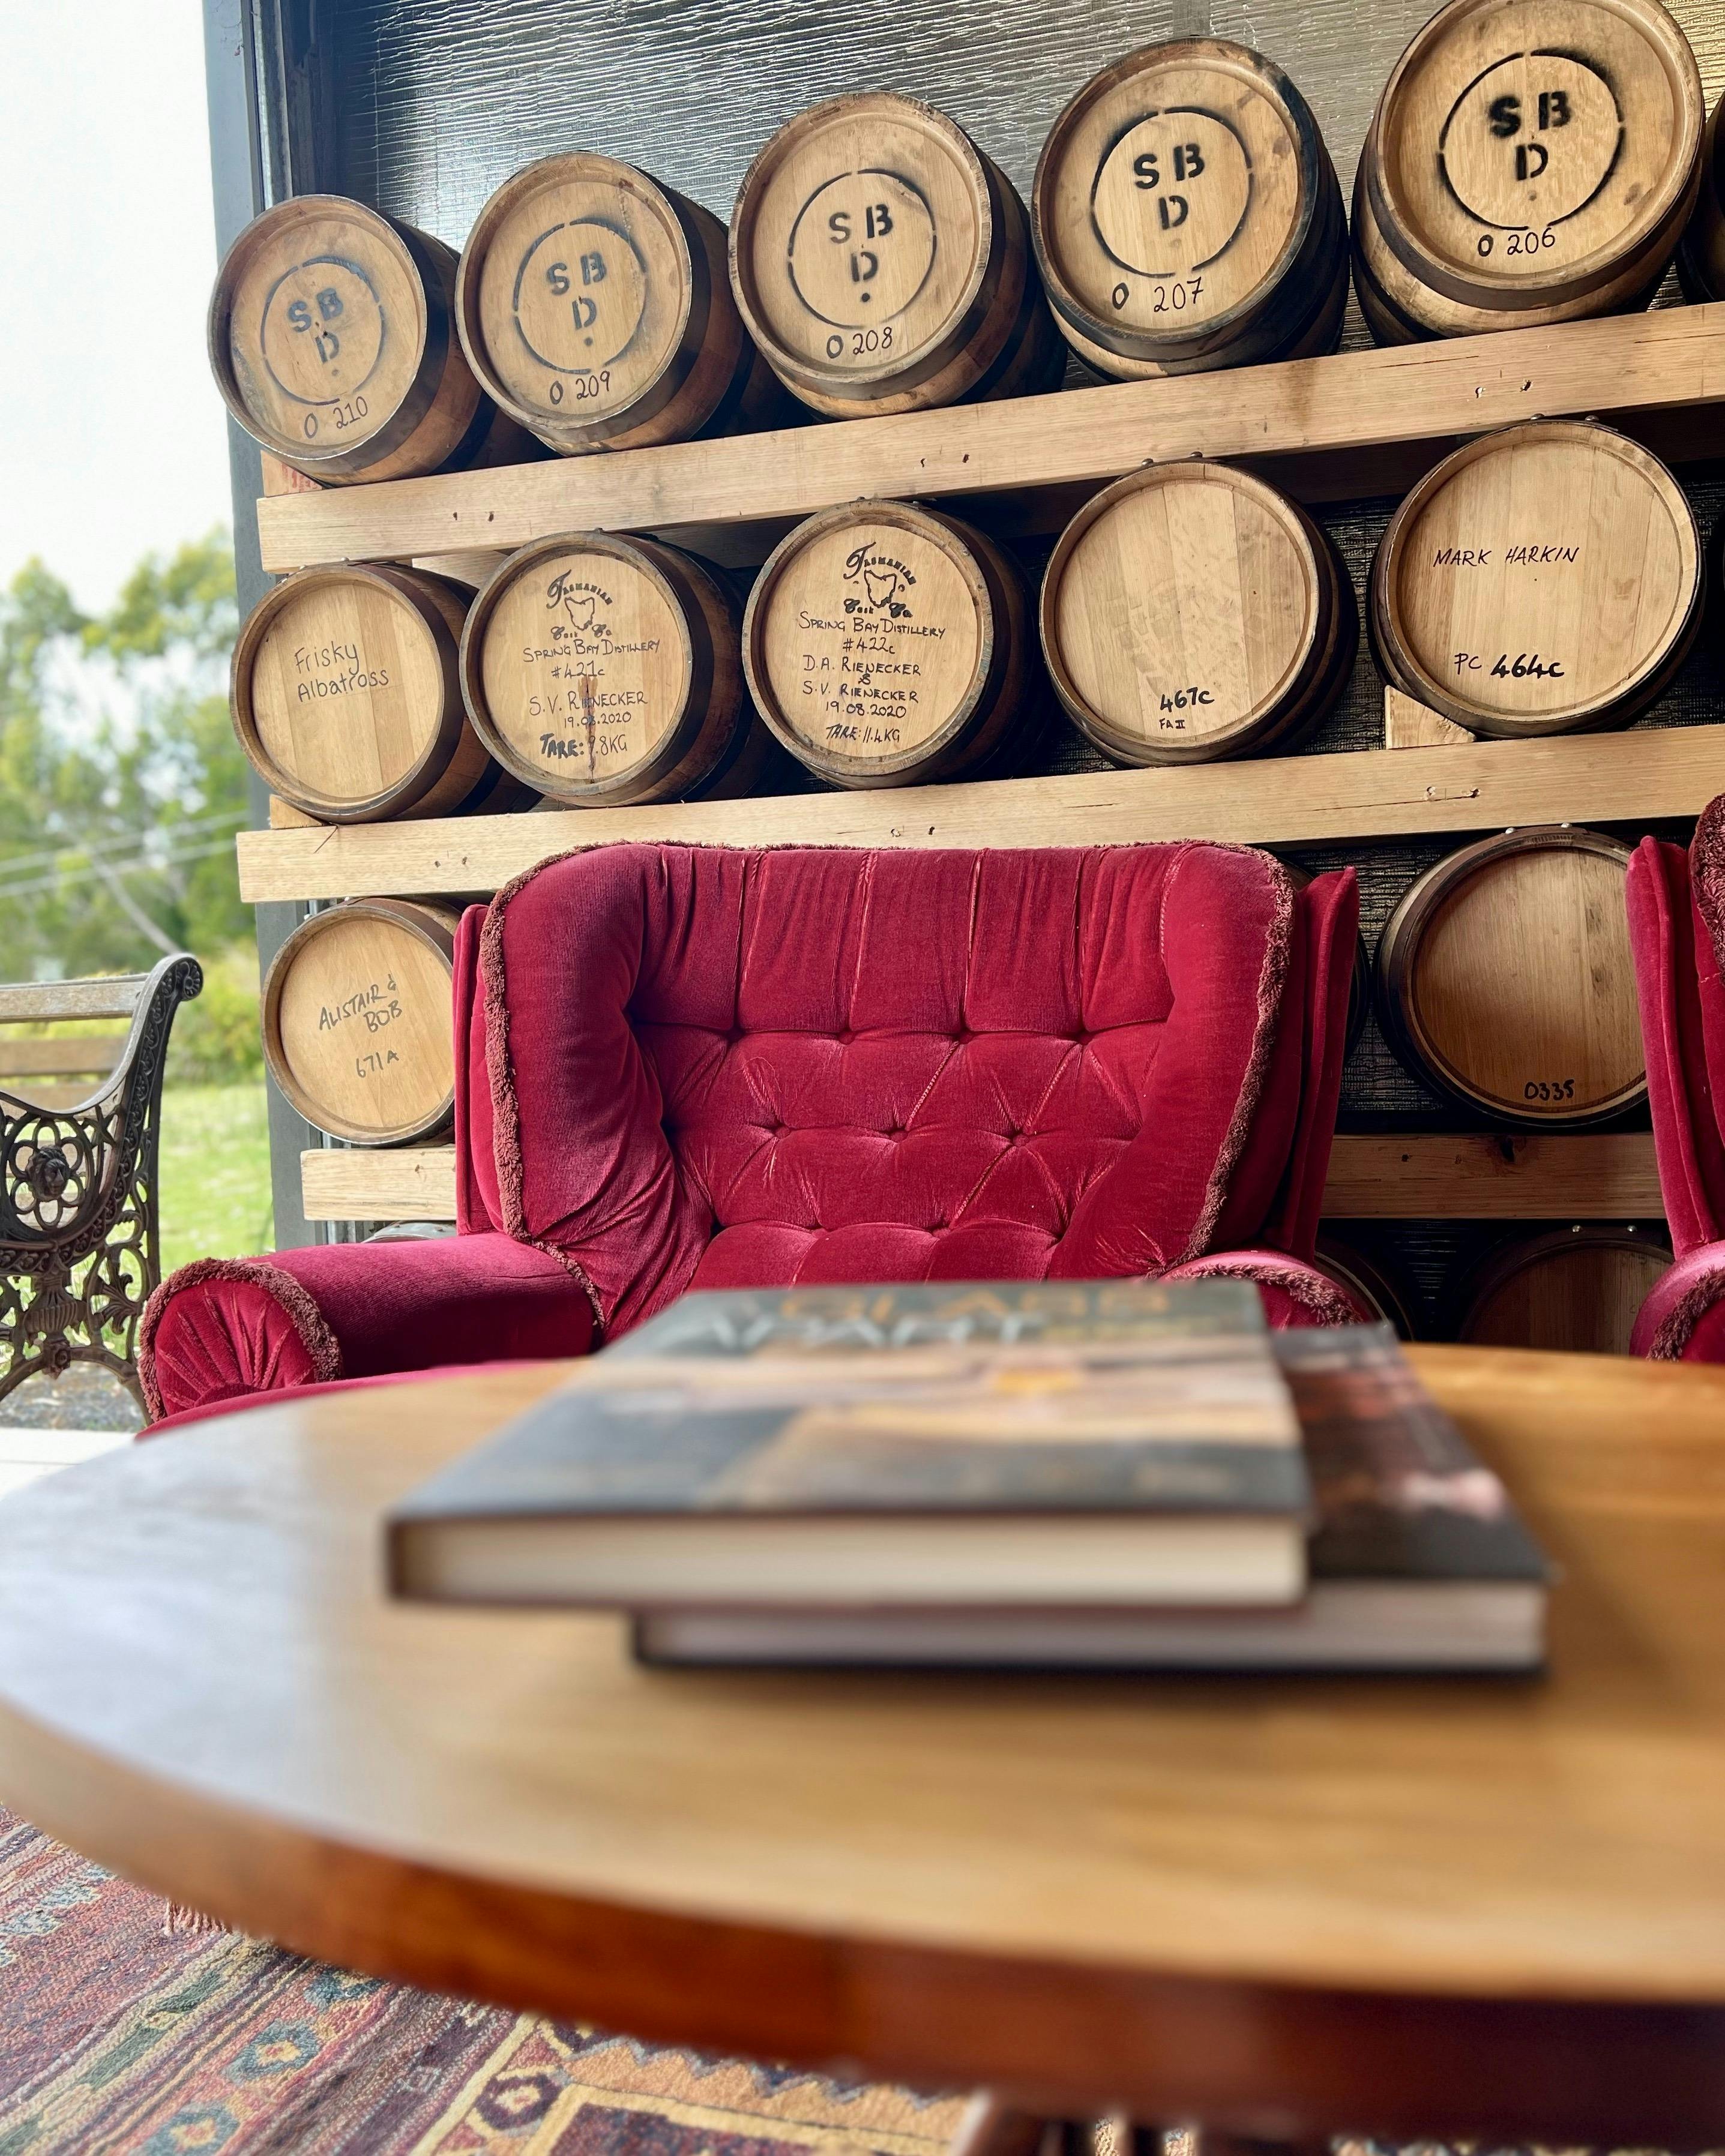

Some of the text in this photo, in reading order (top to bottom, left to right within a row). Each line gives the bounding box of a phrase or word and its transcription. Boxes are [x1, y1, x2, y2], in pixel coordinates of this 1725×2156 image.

[1514, 144, 1549, 180] D
[1158, 196, 1188, 230] D
[1507, 226, 1556, 256] 206
[850, 251, 878, 283] D
[1153, 277, 1204, 313] 207
[573, 296, 597, 330] D
[315, 331, 340, 364] D
[852, 326, 894, 356] 208
[576, 371, 611, 401] 209
[333, 396, 368, 429] 210
[1433, 545, 1580, 568] MARK HARKIN
[799, 611, 947, 640] SPRING BAY DISTILLERY
[294, 640, 360, 676] Frisky
[523, 638, 661, 662] SPRING BAY DISTILLERY
[1454, 652, 1482, 675] PC
[841, 656, 921, 676] RIENECKER
[298, 669, 390, 703] Albatross
[840, 683, 919, 704] RIENECKER
[825, 700, 907, 719] 19.08.2020
[539, 732, 585, 760] TARE:
[825, 723, 862, 741] TARE:
[319, 983, 388, 1030] ALISTAIR
[364, 999, 403, 1033] BOB
